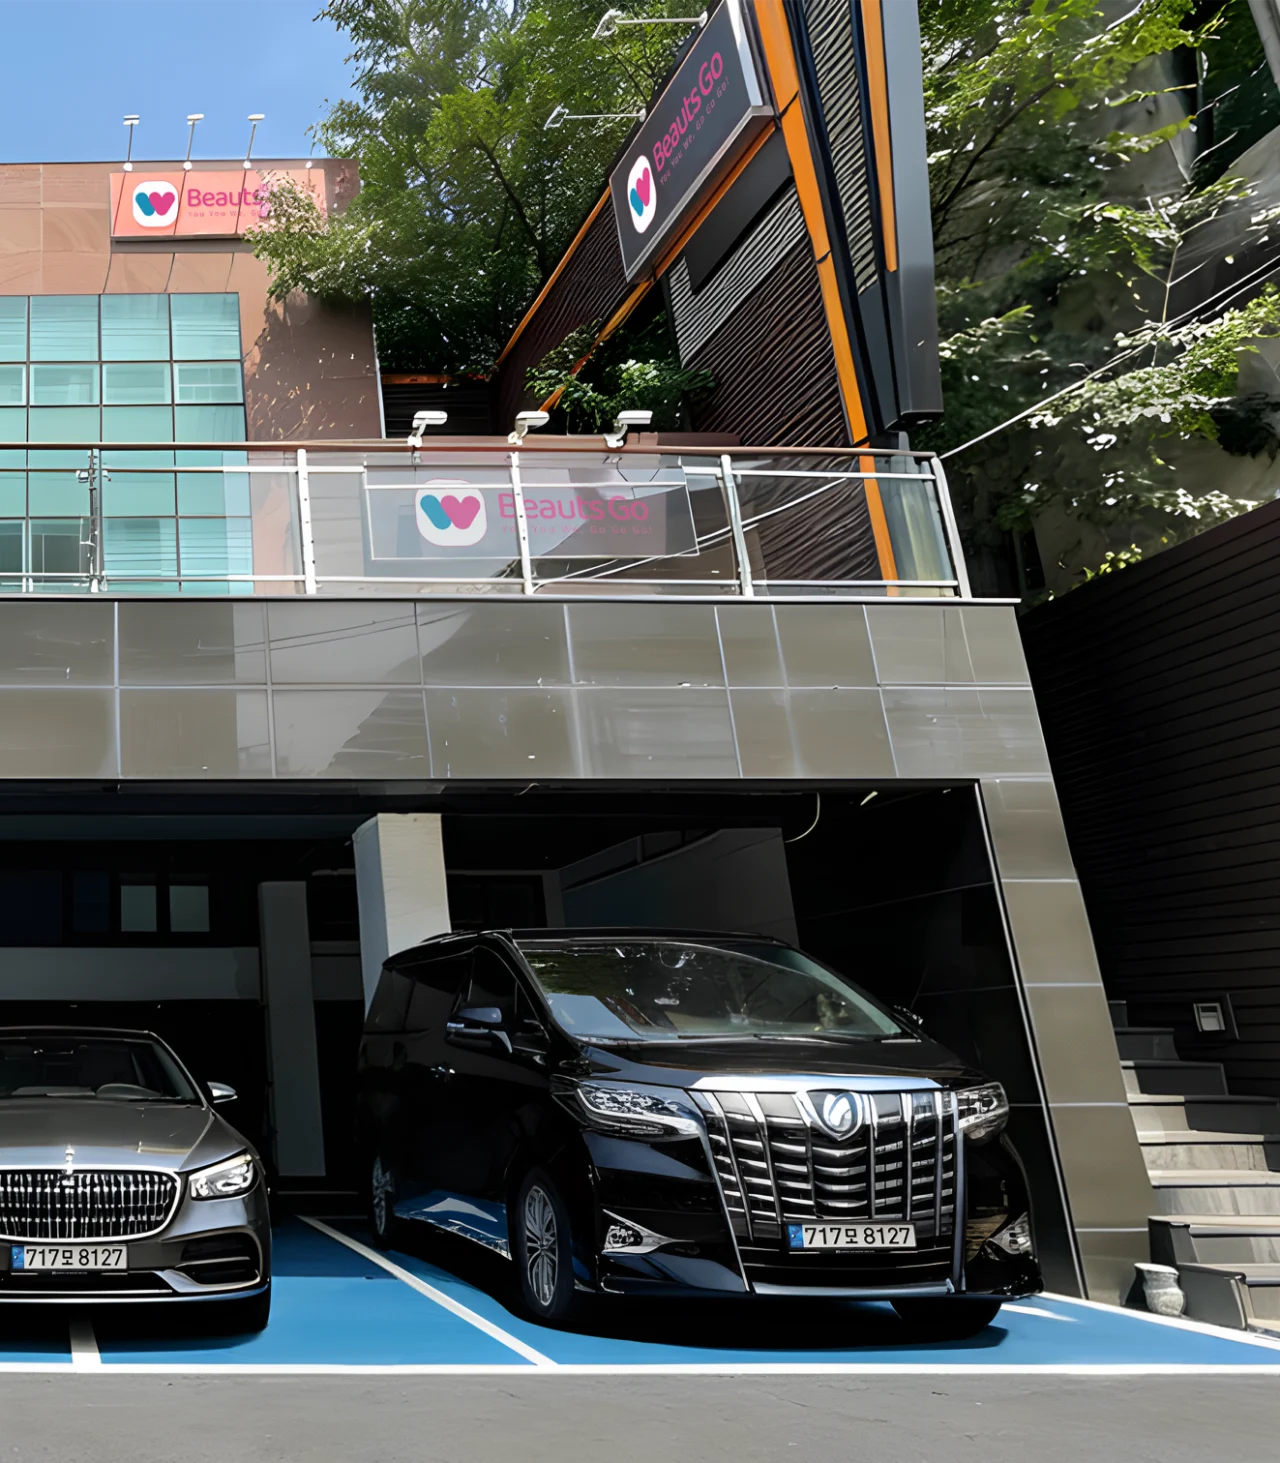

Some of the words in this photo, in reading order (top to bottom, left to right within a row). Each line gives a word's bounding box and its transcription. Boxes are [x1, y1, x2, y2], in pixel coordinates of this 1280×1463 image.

[671, 151, 683, 168] You
[695, 115, 705, 130] Go
[705, 99, 715, 114] Go
[716, 75, 730, 98] Go!
[863, 1227, 910, 1245] 8127
[78, 1248, 123, 1266] 8127
